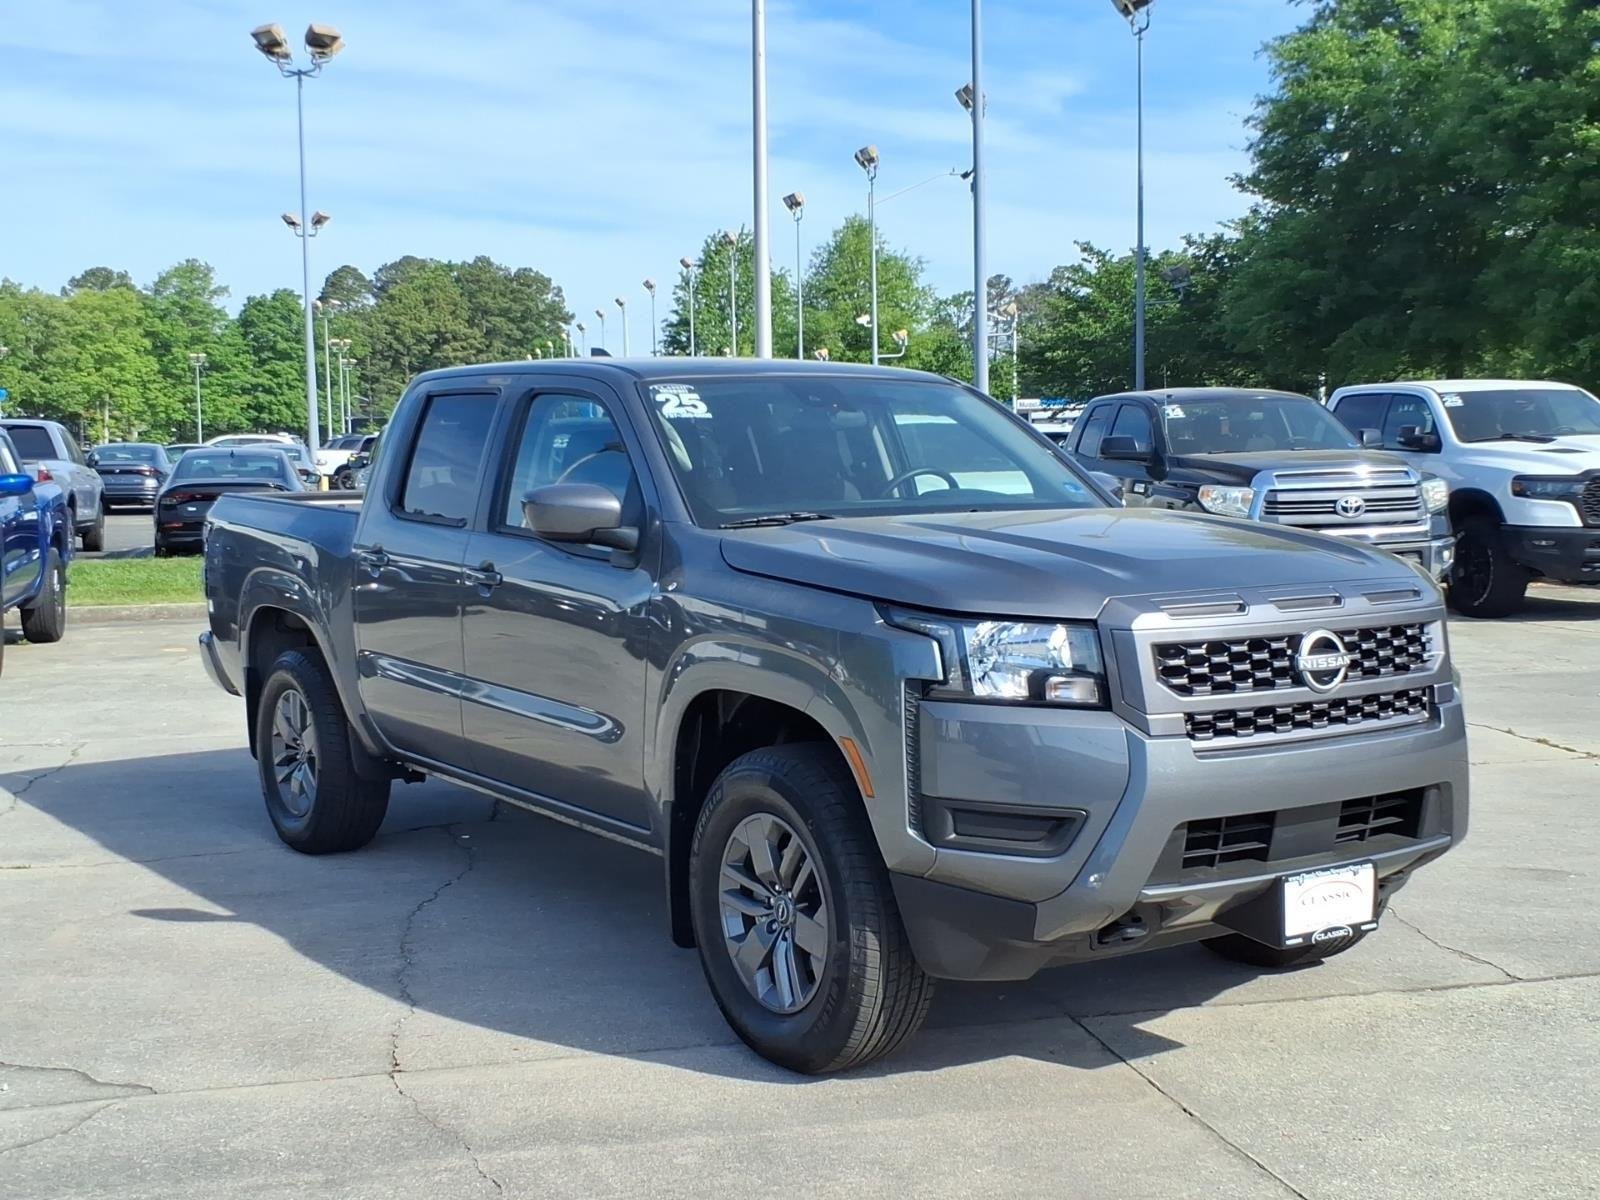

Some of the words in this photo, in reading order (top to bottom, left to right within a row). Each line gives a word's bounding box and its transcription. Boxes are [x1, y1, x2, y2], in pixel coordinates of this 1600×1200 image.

[655, 393, 708, 415] 25
[1299, 656, 1351, 669] NISSAN
[1315, 928, 1350, 941] CLASSIC
